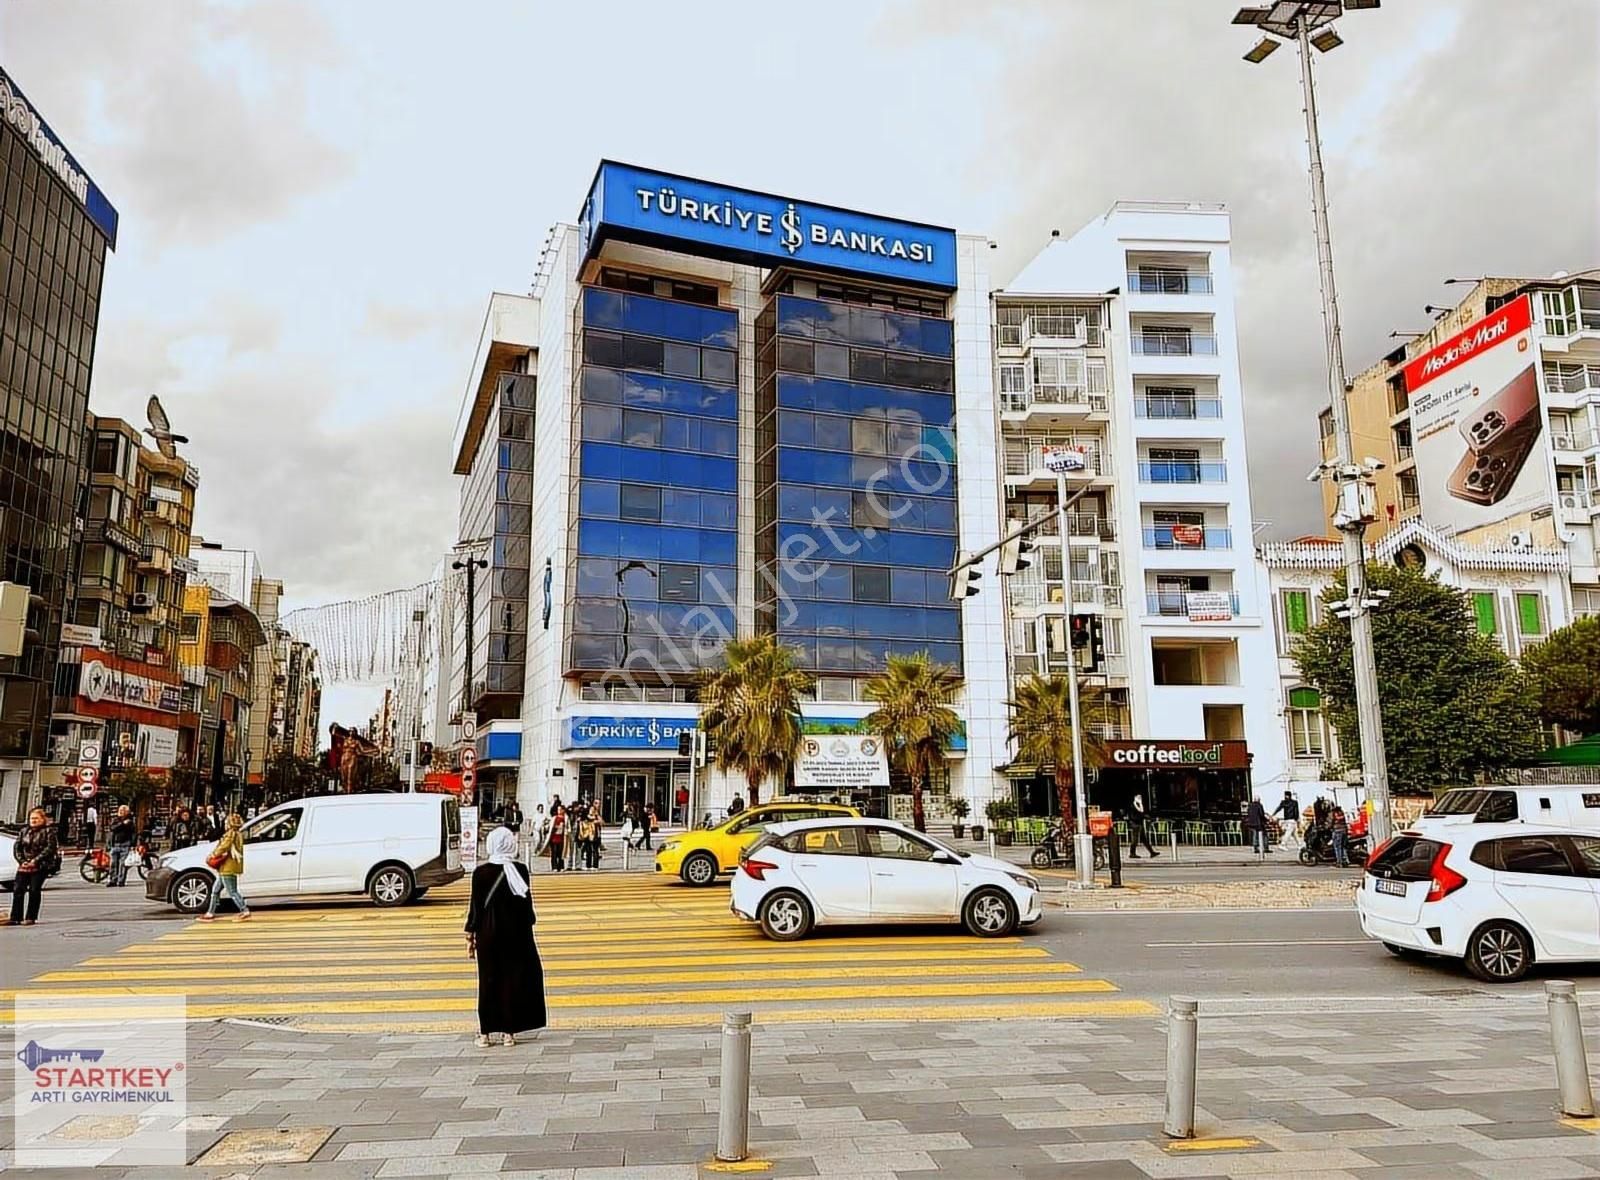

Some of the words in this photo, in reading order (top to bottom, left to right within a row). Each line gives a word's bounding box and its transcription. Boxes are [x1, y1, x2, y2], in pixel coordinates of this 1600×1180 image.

[637, 188, 773, 234] TÜRKİYE
[811, 223, 934, 263] BANKASI
[578, 723, 645, 738] TÜRKİYE
[1113, 744, 1221, 764] coffeekod
